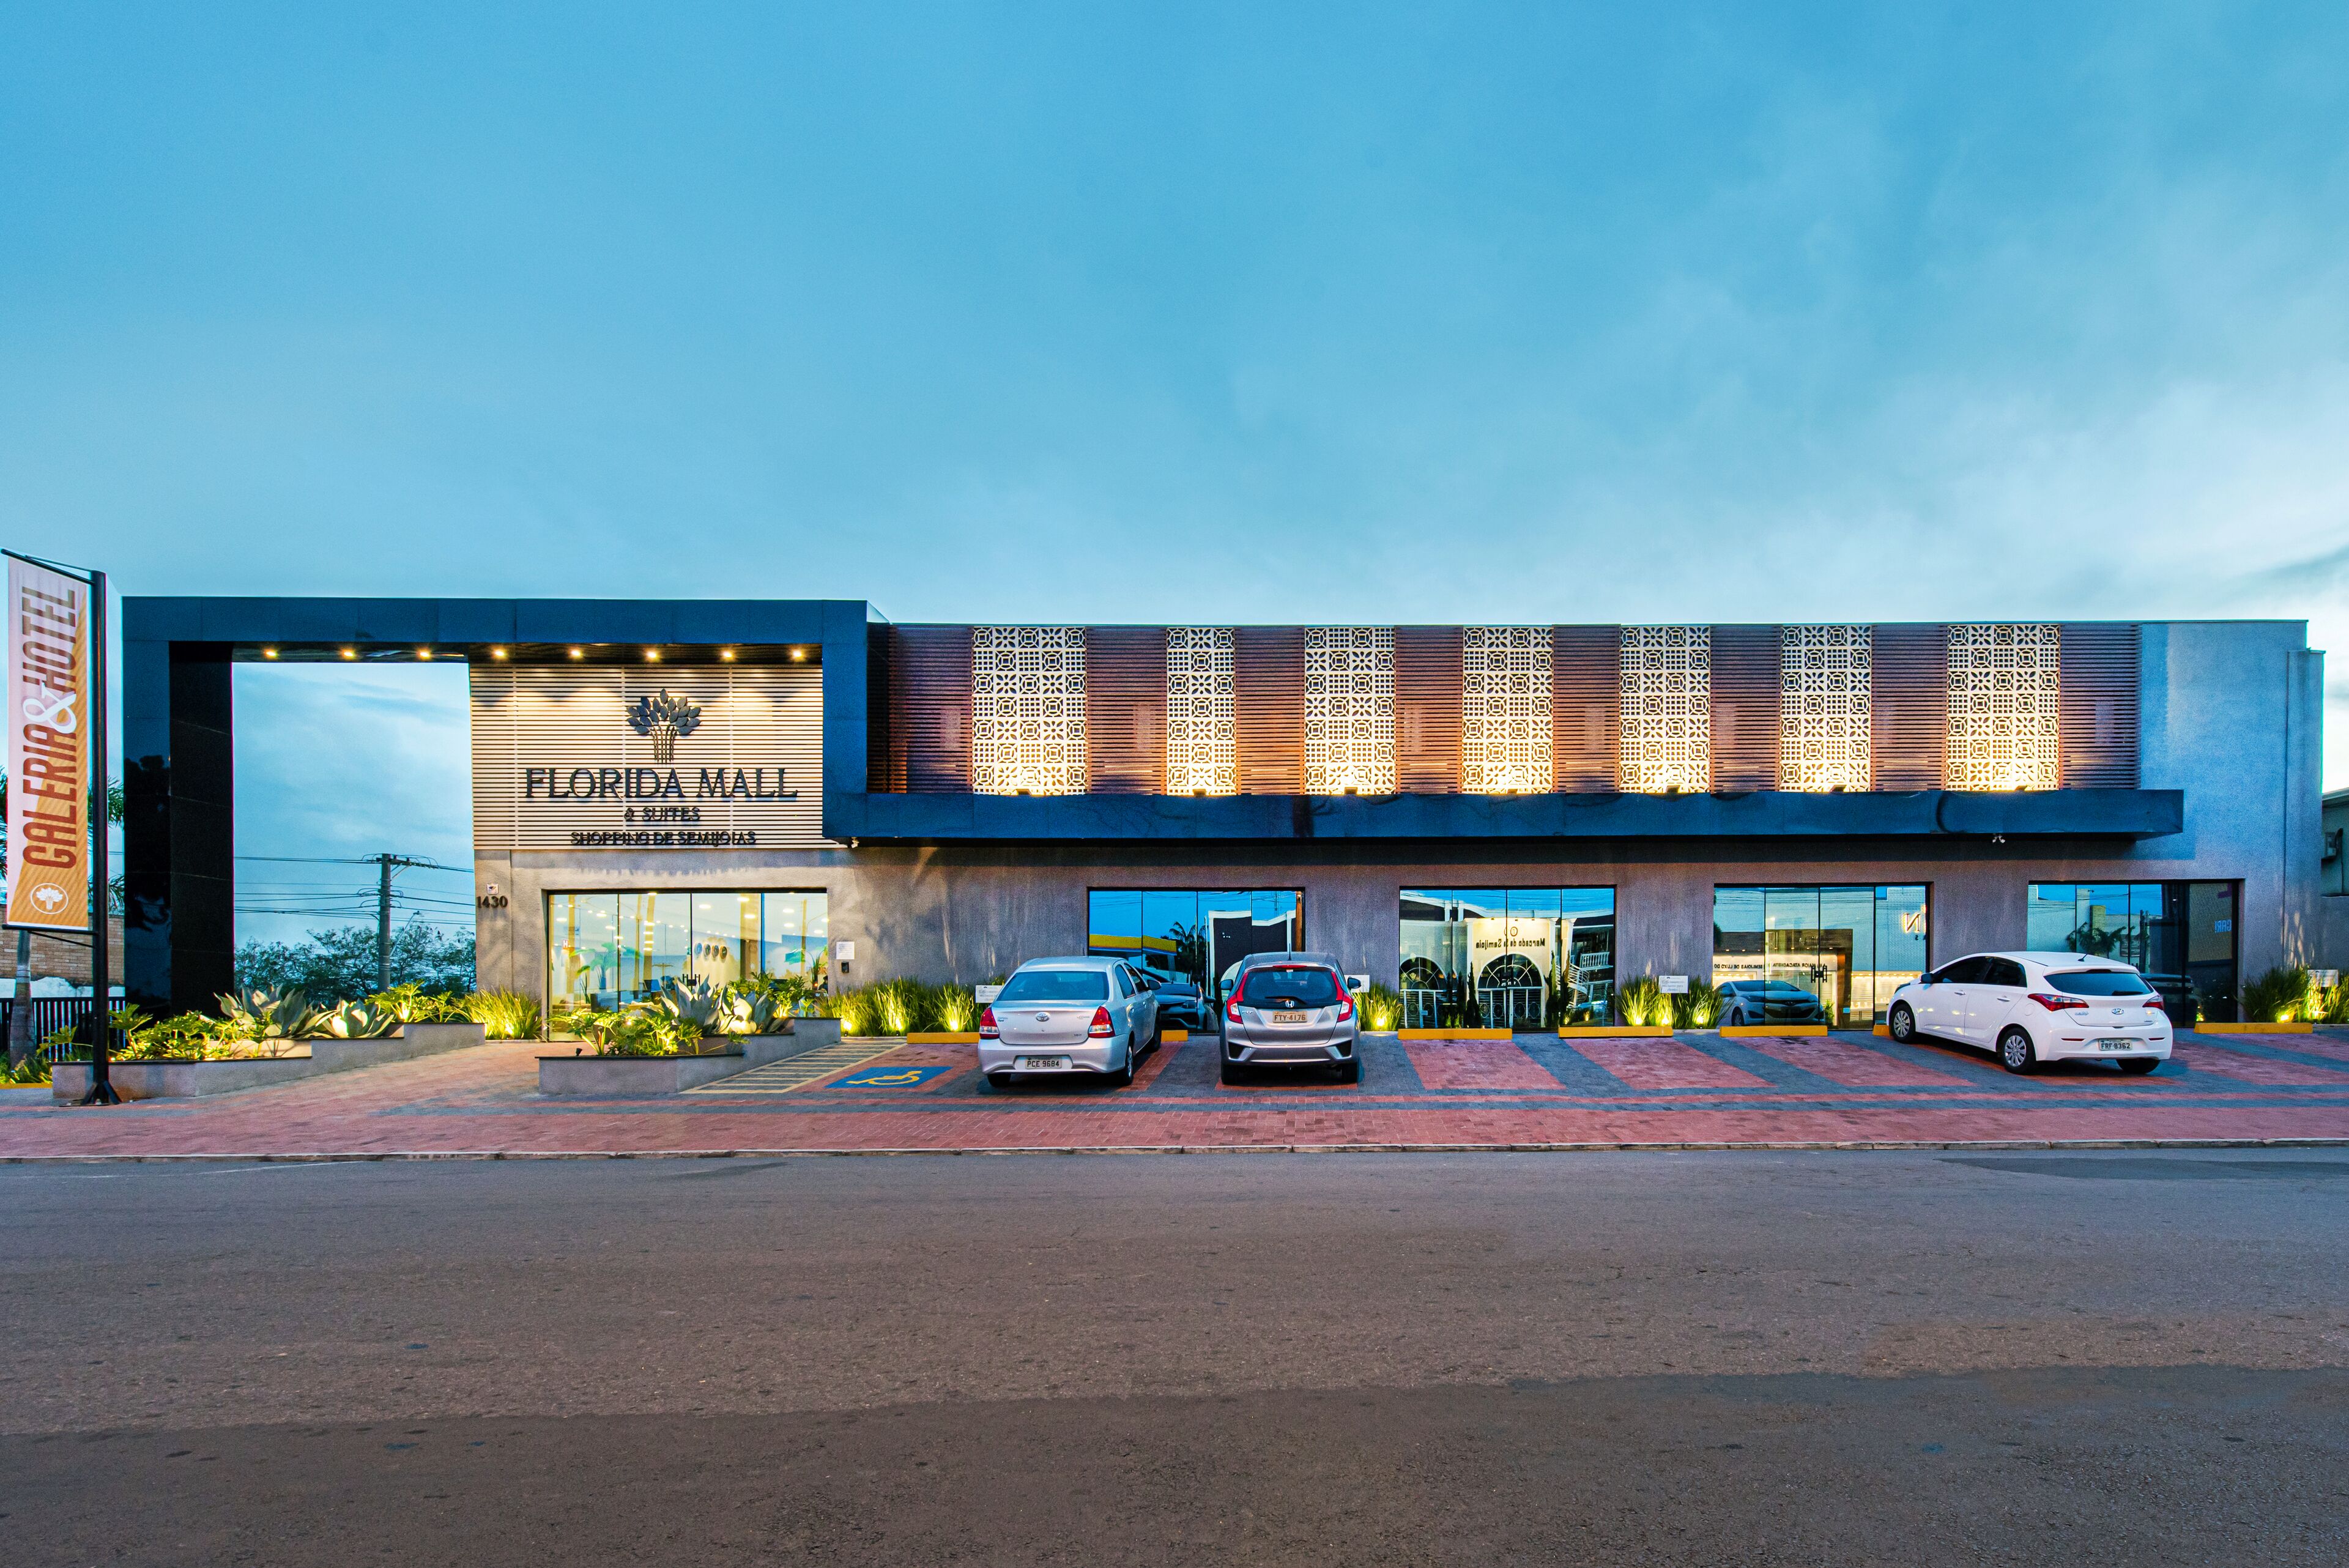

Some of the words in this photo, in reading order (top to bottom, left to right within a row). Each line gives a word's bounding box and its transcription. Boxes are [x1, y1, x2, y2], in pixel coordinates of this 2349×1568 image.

[22, 586, 76, 694] HOTEL
[525, 768, 686, 800] FLORIDA
[696, 767, 798, 797] MALL
[23, 723, 77, 869] GALERIA
[624, 807, 636, 821] &
[642, 806, 700, 822] SUITES
[570, 831, 650, 845] SHOPPING
[653, 831, 674, 845] DE
[677, 831, 757, 847] SEMIJOIAS
[477, 895, 508, 908] 1430
